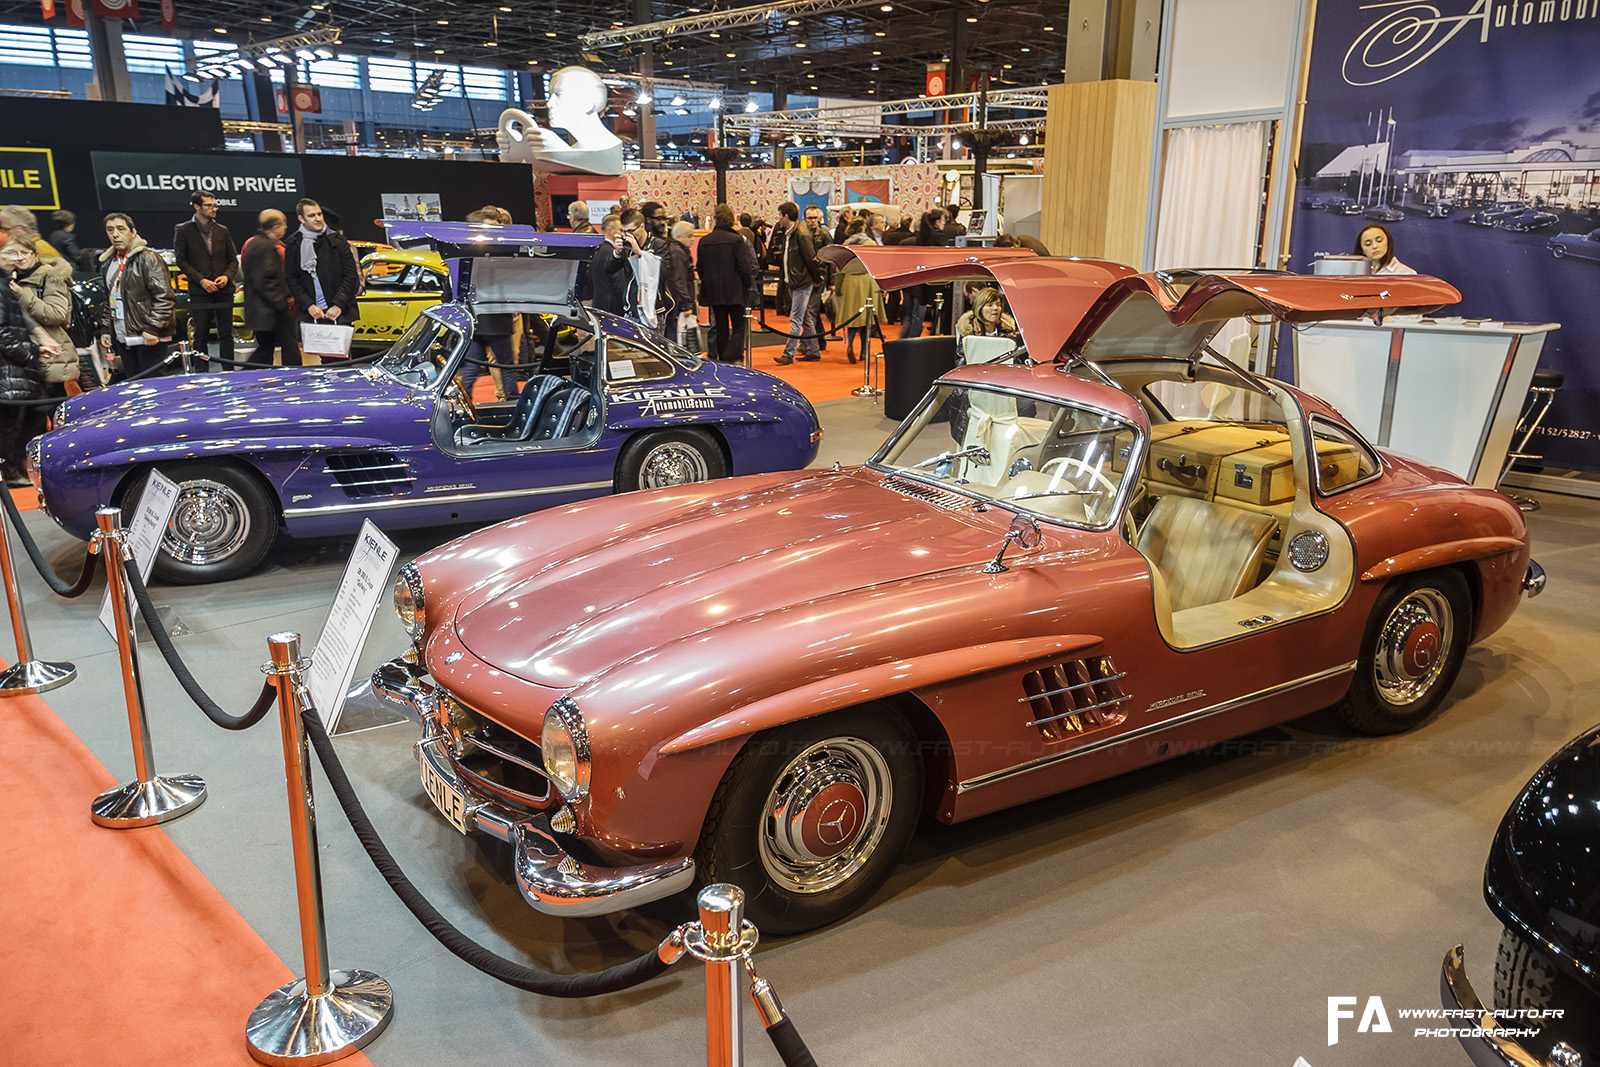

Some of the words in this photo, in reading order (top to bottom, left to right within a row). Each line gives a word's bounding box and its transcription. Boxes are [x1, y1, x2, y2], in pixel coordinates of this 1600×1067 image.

[0, 169, 42, 189] ILE
[105, 173, 229, 191] COLLECTION
[233, 174, 297, 193] PRIVÉE
[611, 387, 726, 402] KIENLE
[1536, 426, 1591, 440] 7152/52827
[363, 533, 388, 562] KIENLE
